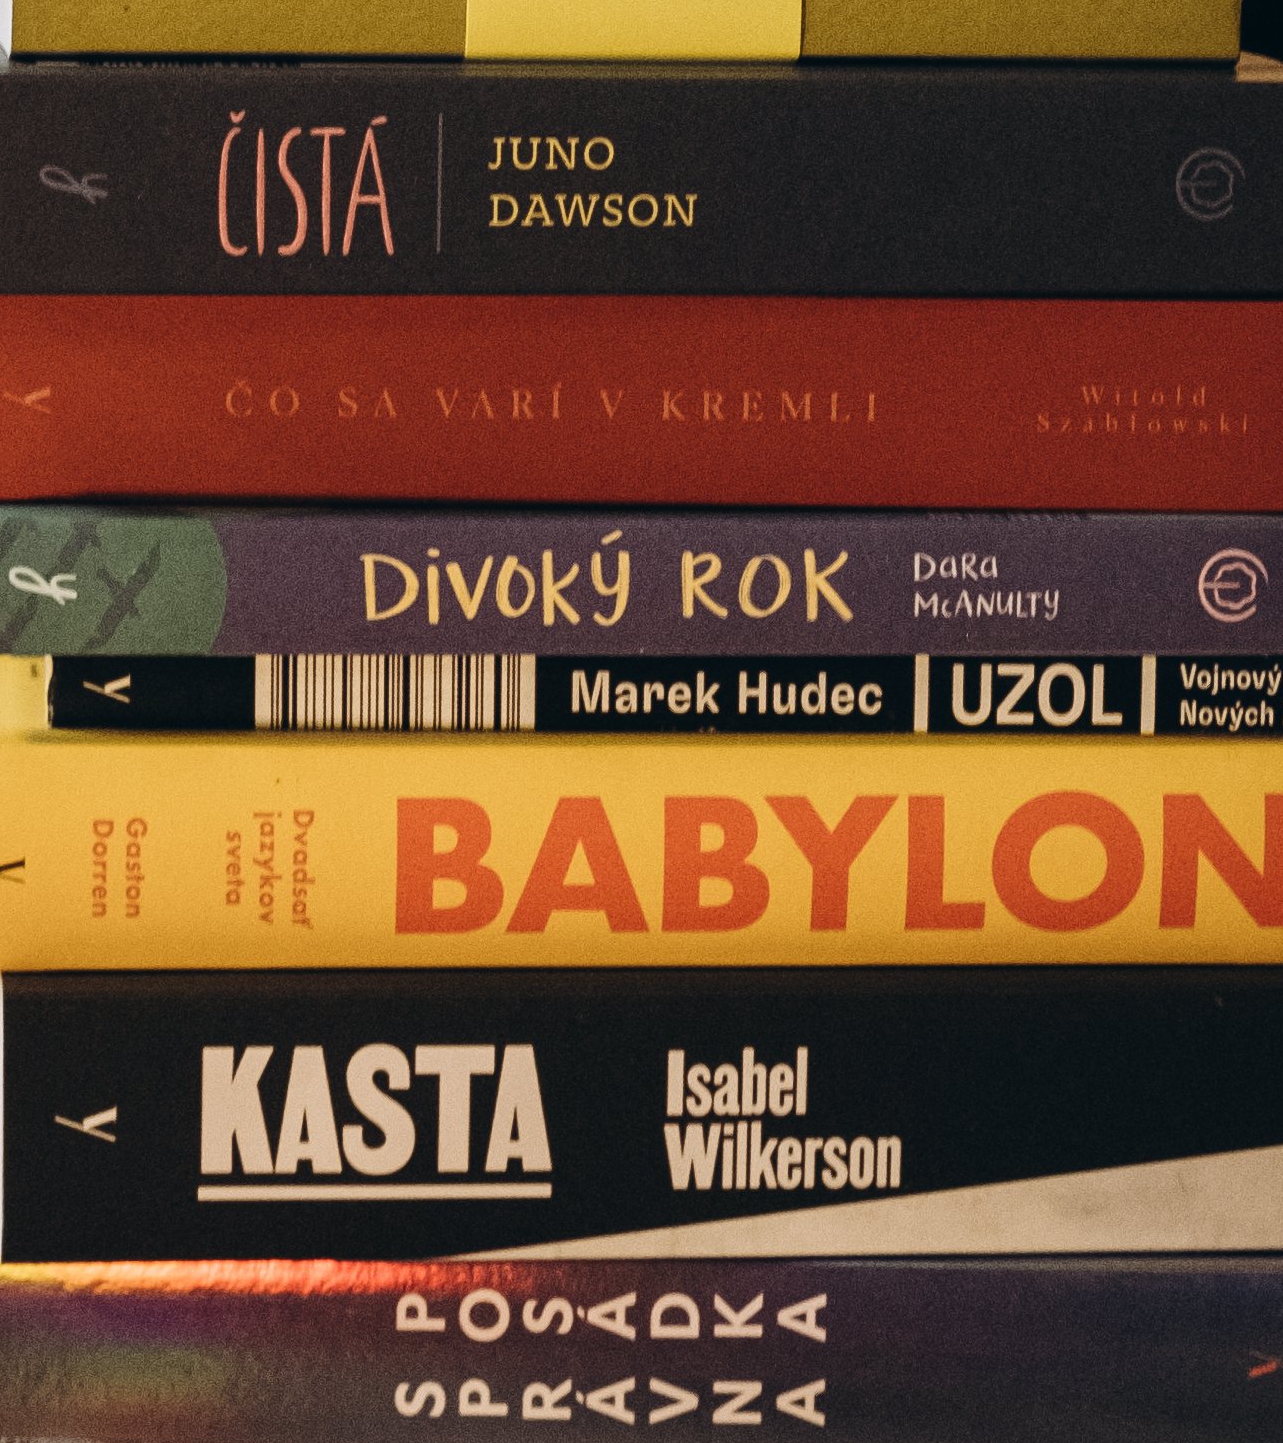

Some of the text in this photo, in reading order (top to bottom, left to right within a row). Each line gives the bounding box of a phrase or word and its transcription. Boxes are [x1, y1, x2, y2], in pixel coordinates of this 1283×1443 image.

[216, 111, 395, 258] ČISTÁ
[487, 135, 616, 175] JUNO
[487, 191, 699, 230] DAWSON
[225, 378, 877, 424] ČO SA VARÍ V KREMLI
[1081, 384, 1206, 407] Witold
[681, 548, 853, 623] ROK
[571, 669, 884, 716] Marek Hudec
[951, 662, 1123, 727] UZOL
[1180, 662, 1282, 696] Vojnový
[1180, 699, 1277, 732] Nových
[91, 819, 115, 919] Dorren
[125, 817, 149, 919] Gaston
[225, 829, 246, 906] sveta
[253, 811, 282, 925] jazykov
[292, 810, 316, 930] Dvadsať
[198, 1044, 553, 1177] KASTA
[666, 1047, 809, 1118] Isabel
[664, 1121, 904, 1192] Wilkerson
